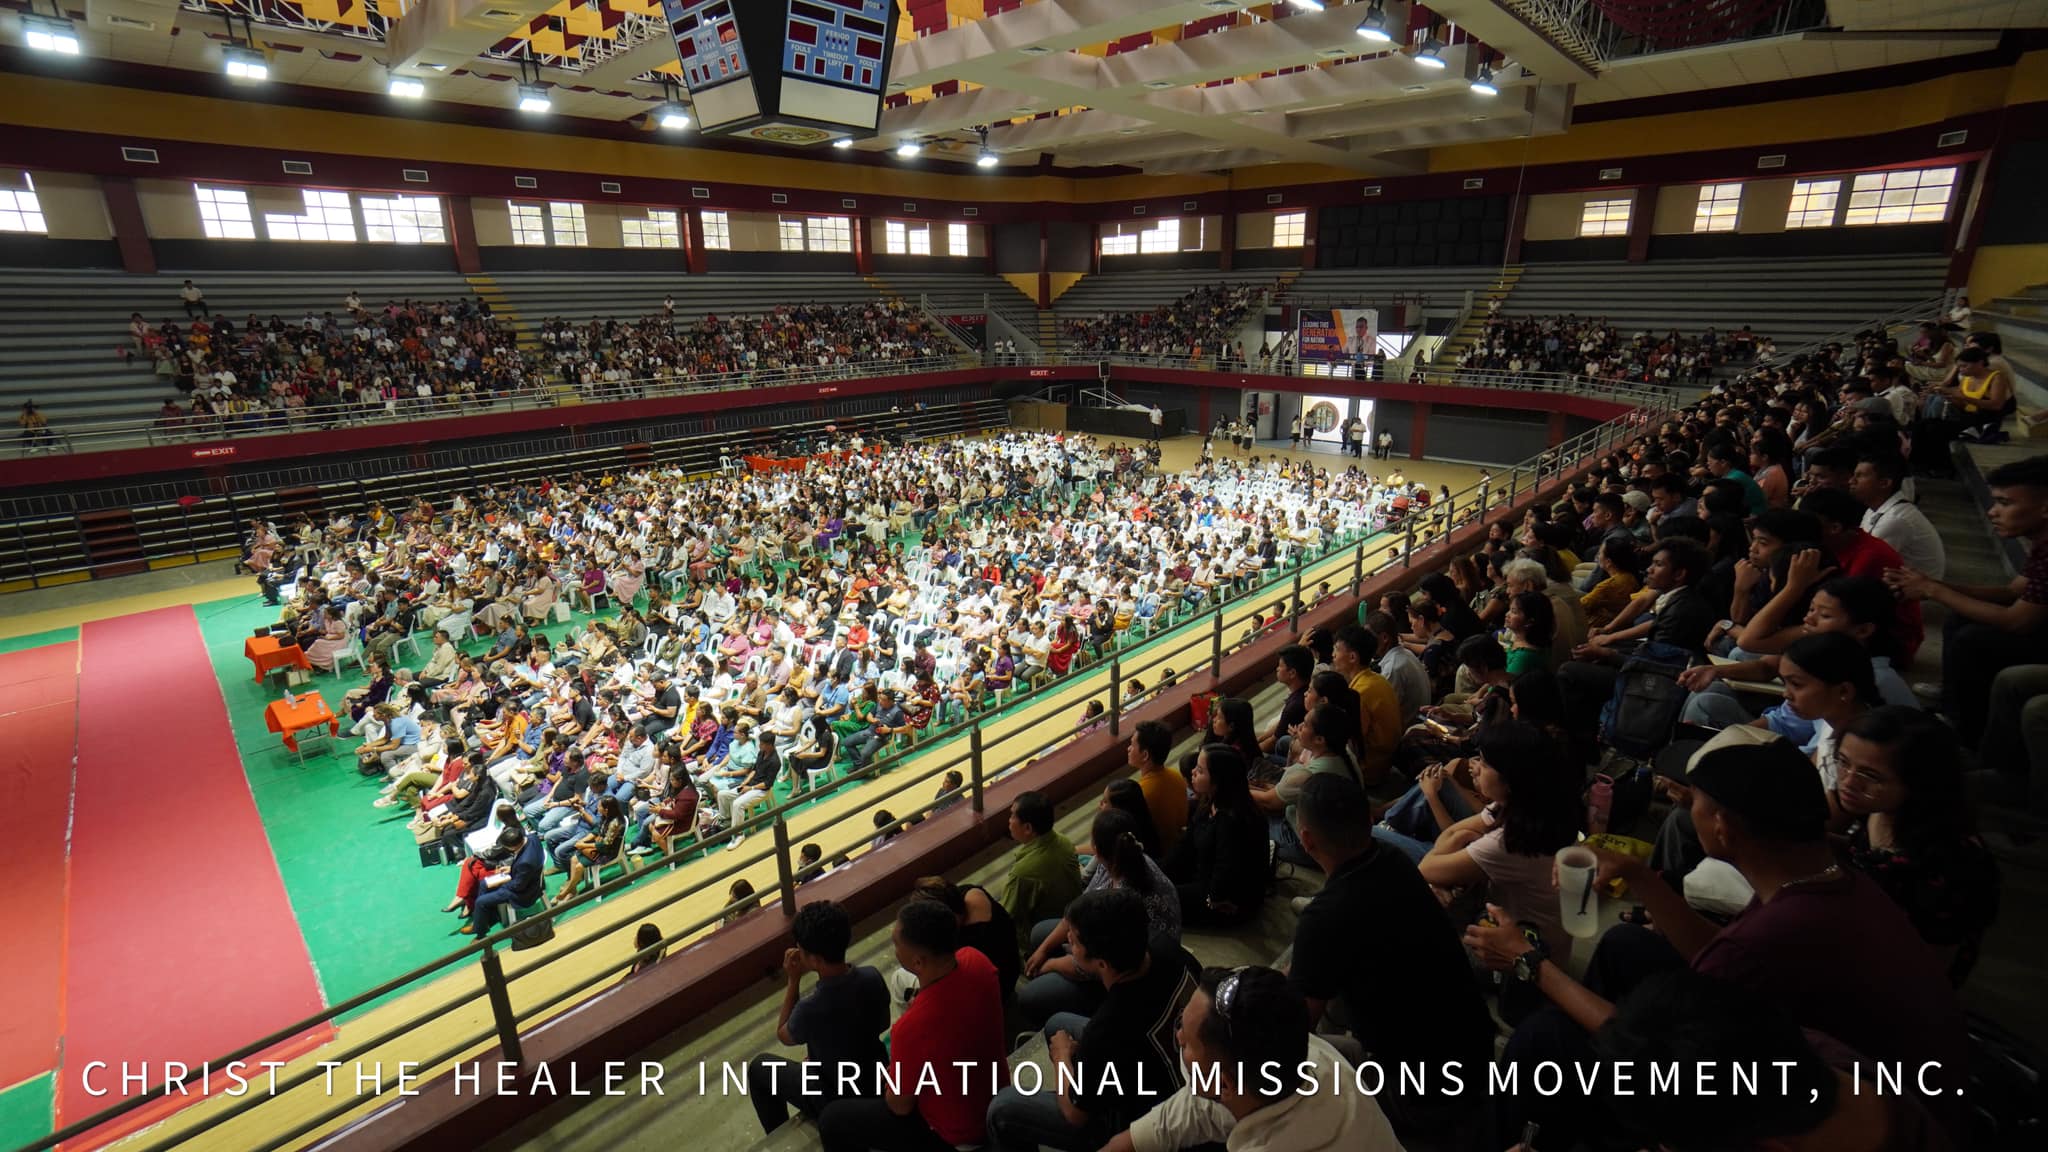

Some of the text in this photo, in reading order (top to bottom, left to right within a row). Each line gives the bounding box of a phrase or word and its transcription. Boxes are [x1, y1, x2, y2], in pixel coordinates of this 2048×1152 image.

[826, 30, 850, 40] PERIOD
[792, 44, 811, 54] FOULS
[823, 50, 849, 61] TIMEOUT
[828, 58, 842, 67] LEFT
[859, 59, 877, 68] FOULS
[211, 447, 235, 456] EXIT
